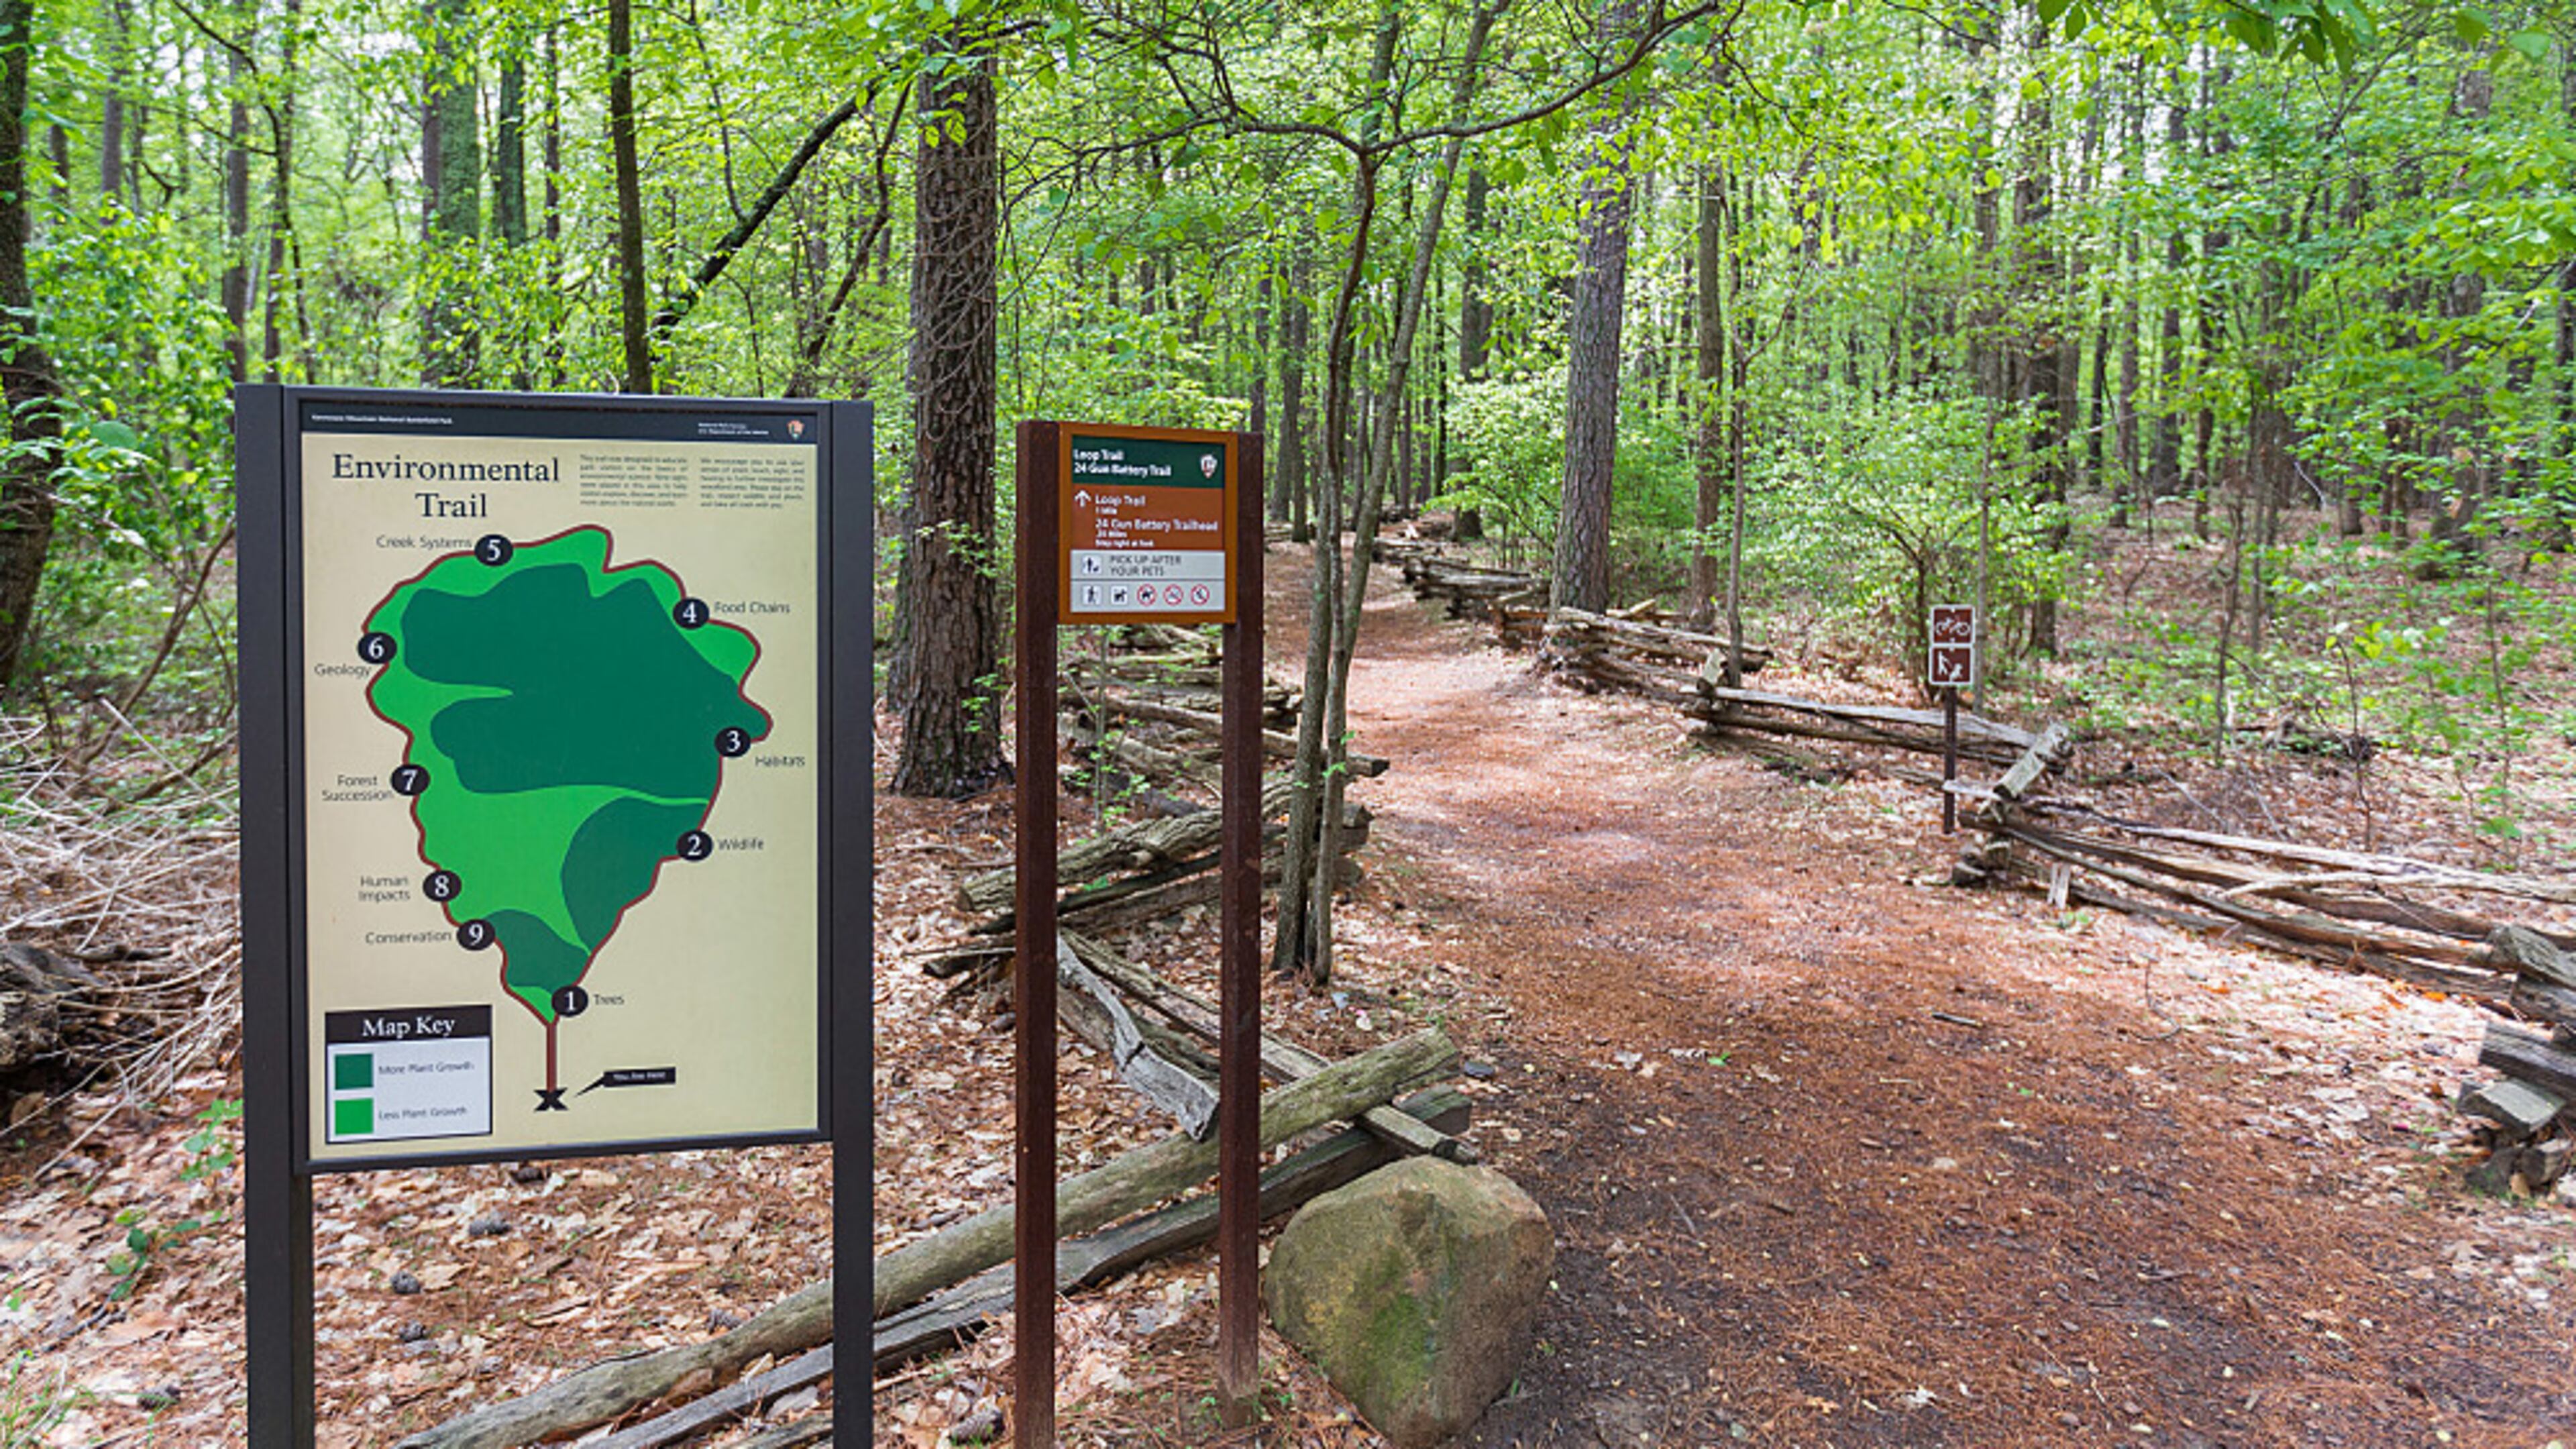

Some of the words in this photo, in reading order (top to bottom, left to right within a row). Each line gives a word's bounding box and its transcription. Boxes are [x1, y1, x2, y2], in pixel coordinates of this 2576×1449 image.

[1073, 449, 1100, 461] Loop
[1101, 449, 1124, 460] Trail
[332, 453, 559, 482] Environmental
[1074, 462, 1086, 474] 24
[1088, 462, 1109, 474] Gun
[1111, 464, 1148, 479] Battery
[1149, 464, 1172, 476] Trail
[415, 493, 487, 518] Trail
[1095, 495, 1122, 506] Loop
[1124, 495, 1145, 506] Trail
[1095, 518, 1108, 529] 24
[1111, 519, 1132, 529] Gun
[1134, 519, 1171, 533] Battery
[1173, 519, 1218, 531] Trailhead
[376, 535, 415, 548] Creek
[419, 536, 472, 551] Systems
[486, 539, 501, 561] 5
[1111, 555, 1132, 564] PICK
[1134, 555, 1148, 564] UP
[1152, 555, 1181, 565] AFTER
[1111, 566, 1139, 576] YOUR
[1142, 566, 1165, 576] PETS
[682, 602, 697, 623] 4
[714, 601, 745, 613] Food
[749, 602, 790, 614] Chains
[368, 637, 384, 659] 6
[314, 663, 372, 678] Geology
[727, 730, 741, 752] 3
[755, 755, 806, 767] Habitats
[337, 775, 378, 786] Forest
[402, 769, 417, 792] 7
[322, 790, 393, 801] Succession
[688, 834, 702, 856] 2
[718, 838, 764, 851] Wildlife
[360, 875, 409, 887] Human
[435, 875, 449, 897] 8
[358, 890, 411, 904] Impacts
[366, 930, 452, 944] Conservation
[469, 923, 484, 946] 9
[564, 991, 576, 1012] 1
[594, 994, 625, 1006] Trees
[362, 1017, 411, 1039] Map
[417, 1015, 455, 1036] Key
[378, 1065, 405, 1075] More
[409, 1063, 433, 1073] Plant
[436, 1061, 474, 1073] Growth
[378, 1110, 400, 1121] Less
[402, 1108, 426, 1119] Plant
[431, 1106, 467, 1118] Growth
